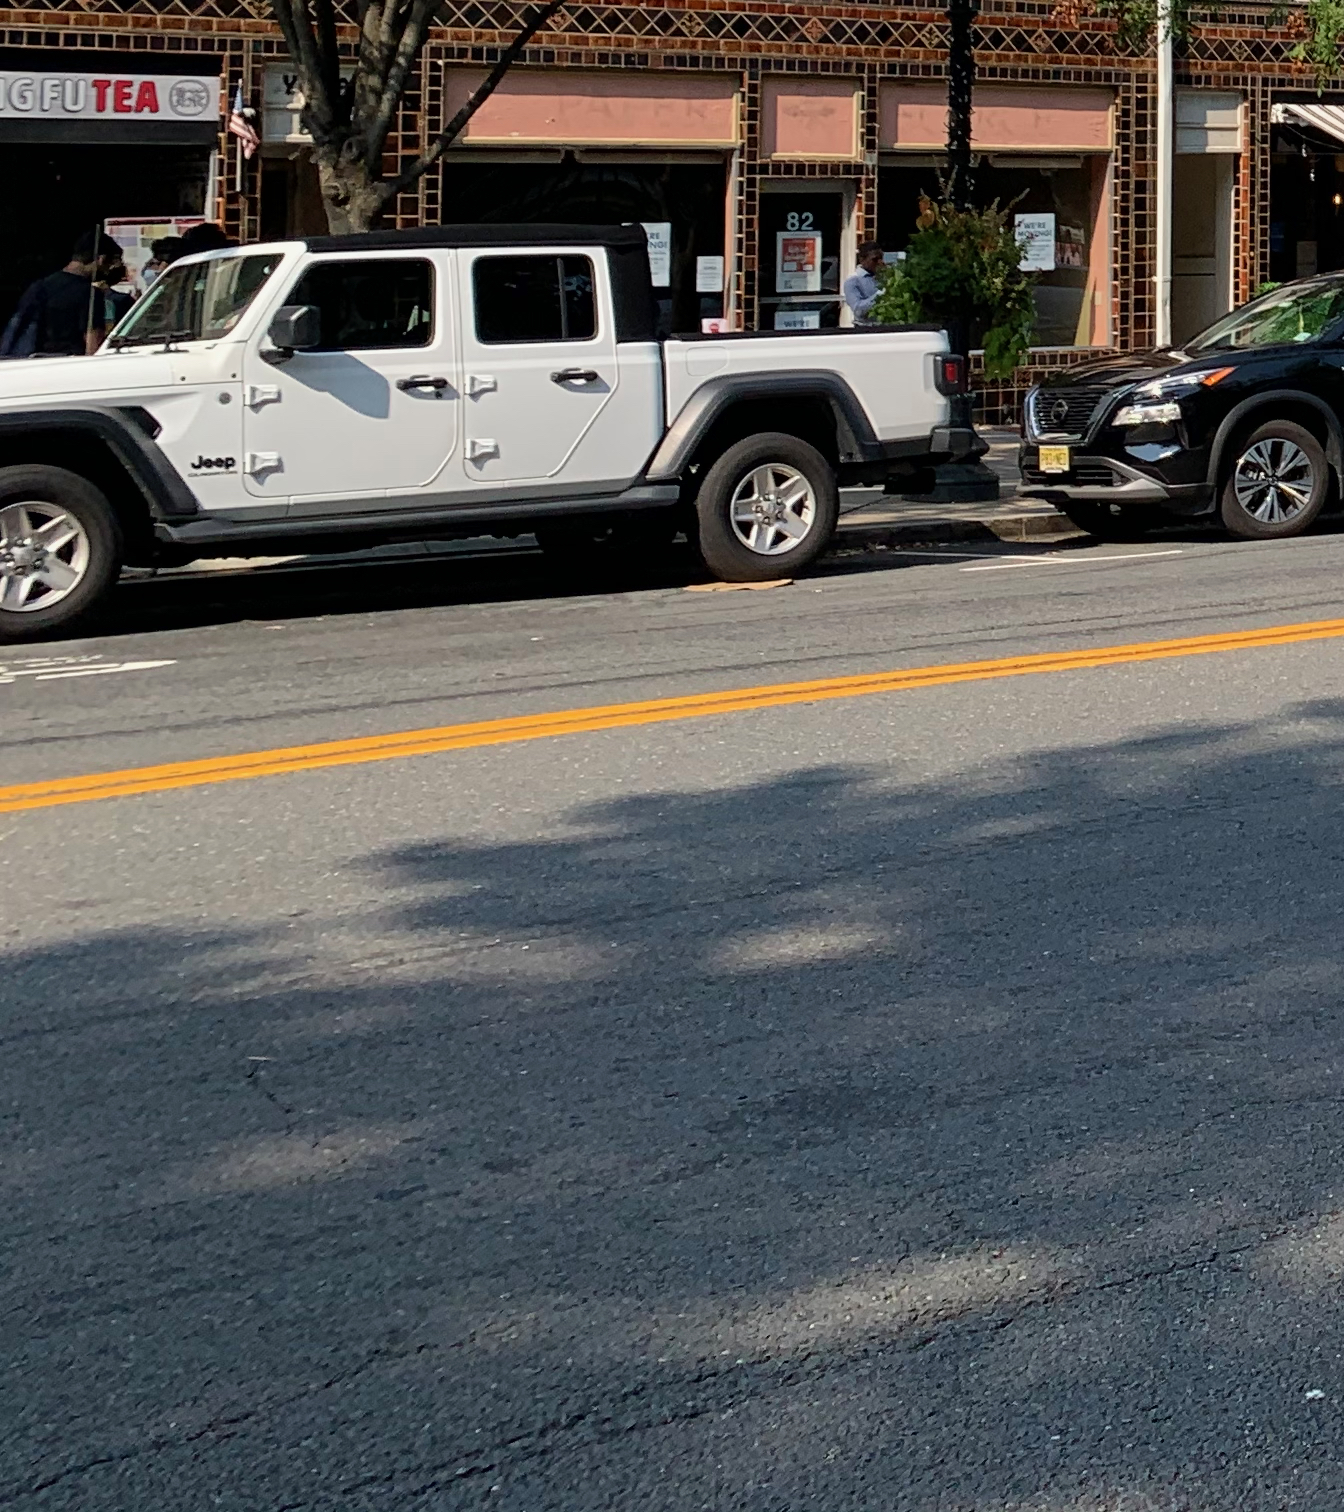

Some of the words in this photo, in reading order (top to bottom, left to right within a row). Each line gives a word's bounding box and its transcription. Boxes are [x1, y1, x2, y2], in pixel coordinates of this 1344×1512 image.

[92, 79, 160, 113] TEA
[786, 211, 814, 231] 82
[191, 454, 236, 470] Jeep
